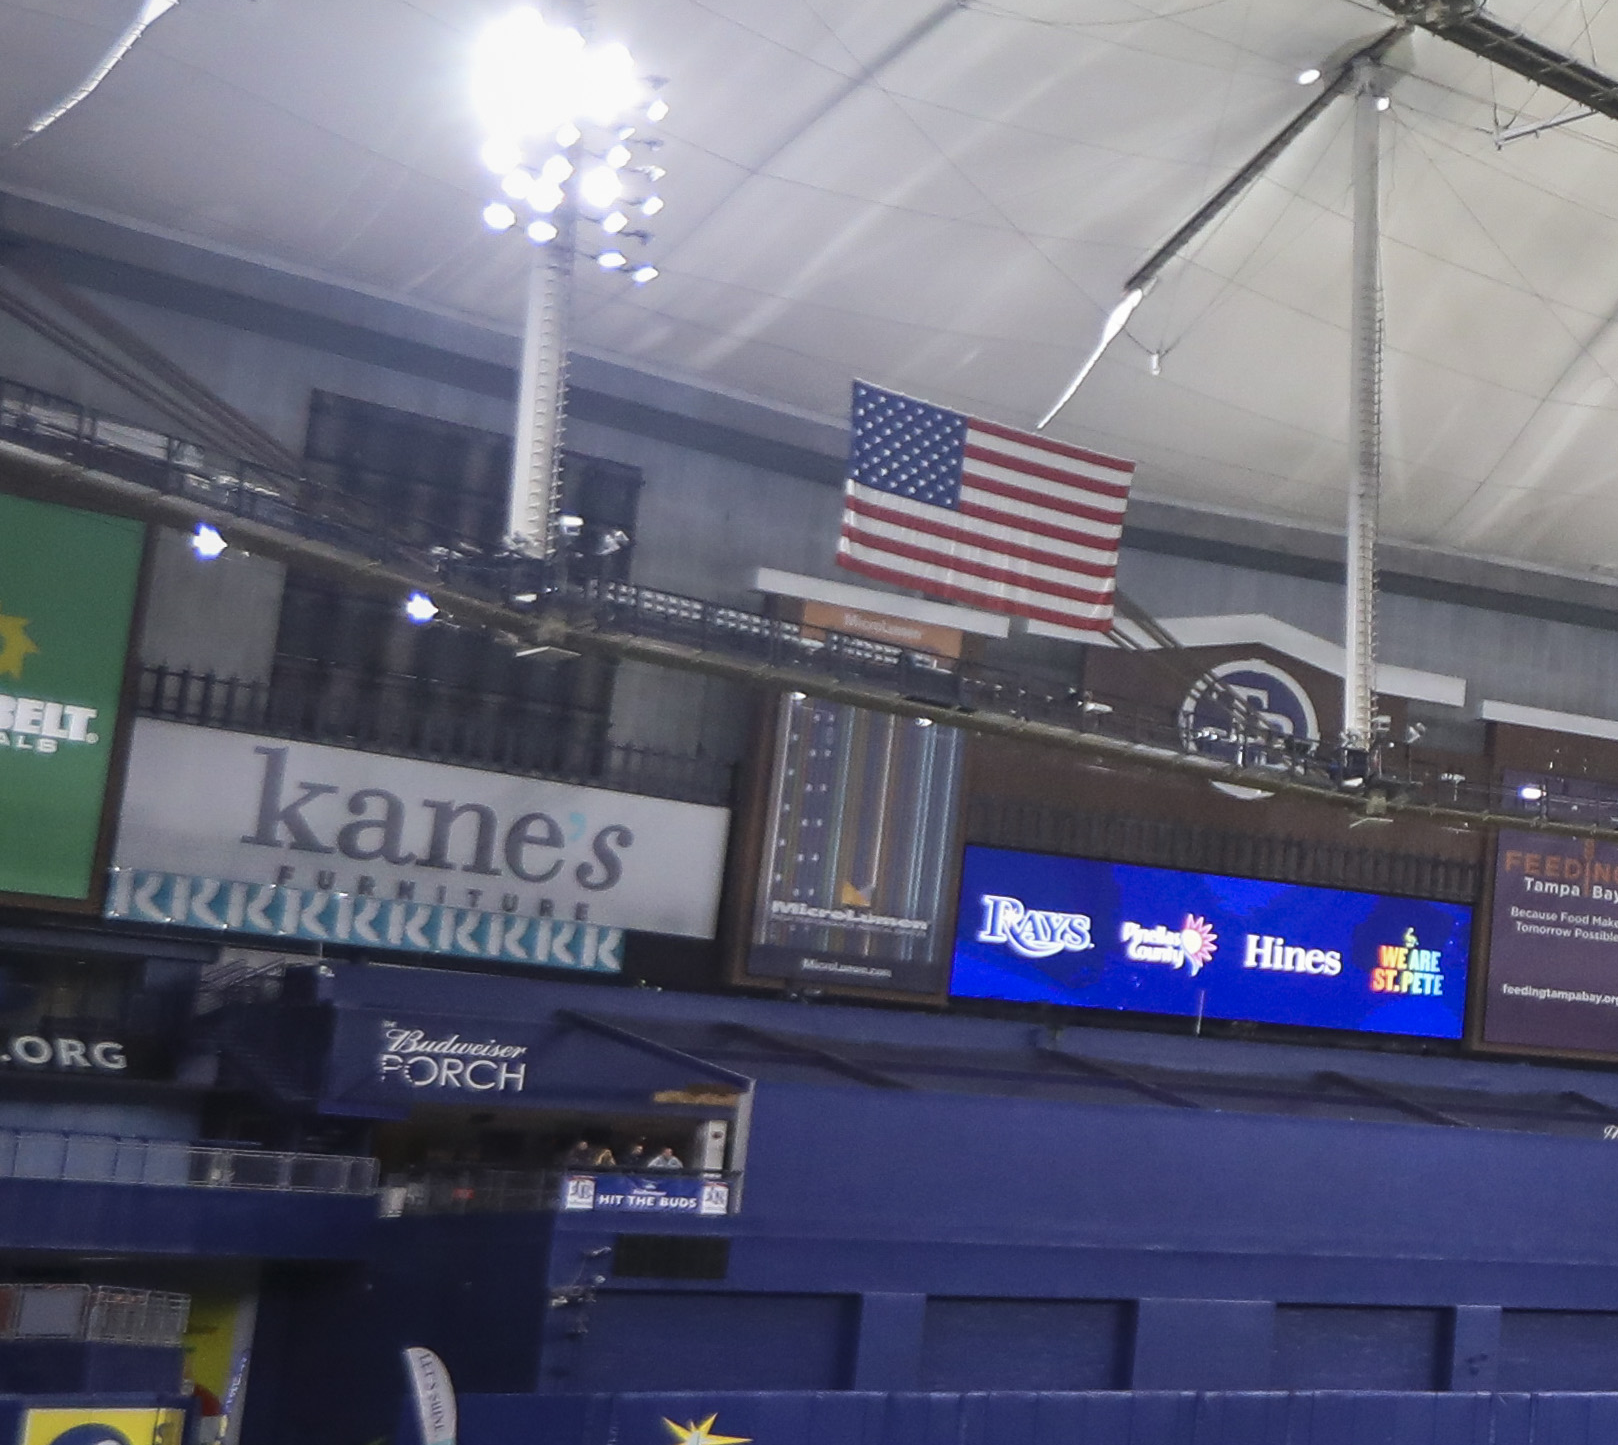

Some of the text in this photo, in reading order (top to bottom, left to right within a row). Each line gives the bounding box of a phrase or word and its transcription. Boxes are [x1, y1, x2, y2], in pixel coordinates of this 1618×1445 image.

[241, 746, 635, 891] kane's
[276, 865, 590, 921] FURNITURE
[1524, 876, 1581, 898] Tampa
[980, 893, 1094, 958] RAYS
[1510, 906, 1558, 922] Because
[1560, 911, 1590, 925] Food
[1515, 920, 1572, 937] Tomorrow
[1244, 933, 1342, 977] Hines
[1379, 945, 1442, 973] WE ARE
[386, 1029, 529, 1059] Budweiser
[382, 1054, 527, 1091] PORCH
[600, 1194, 698, 1208] HIT THE BUDS
